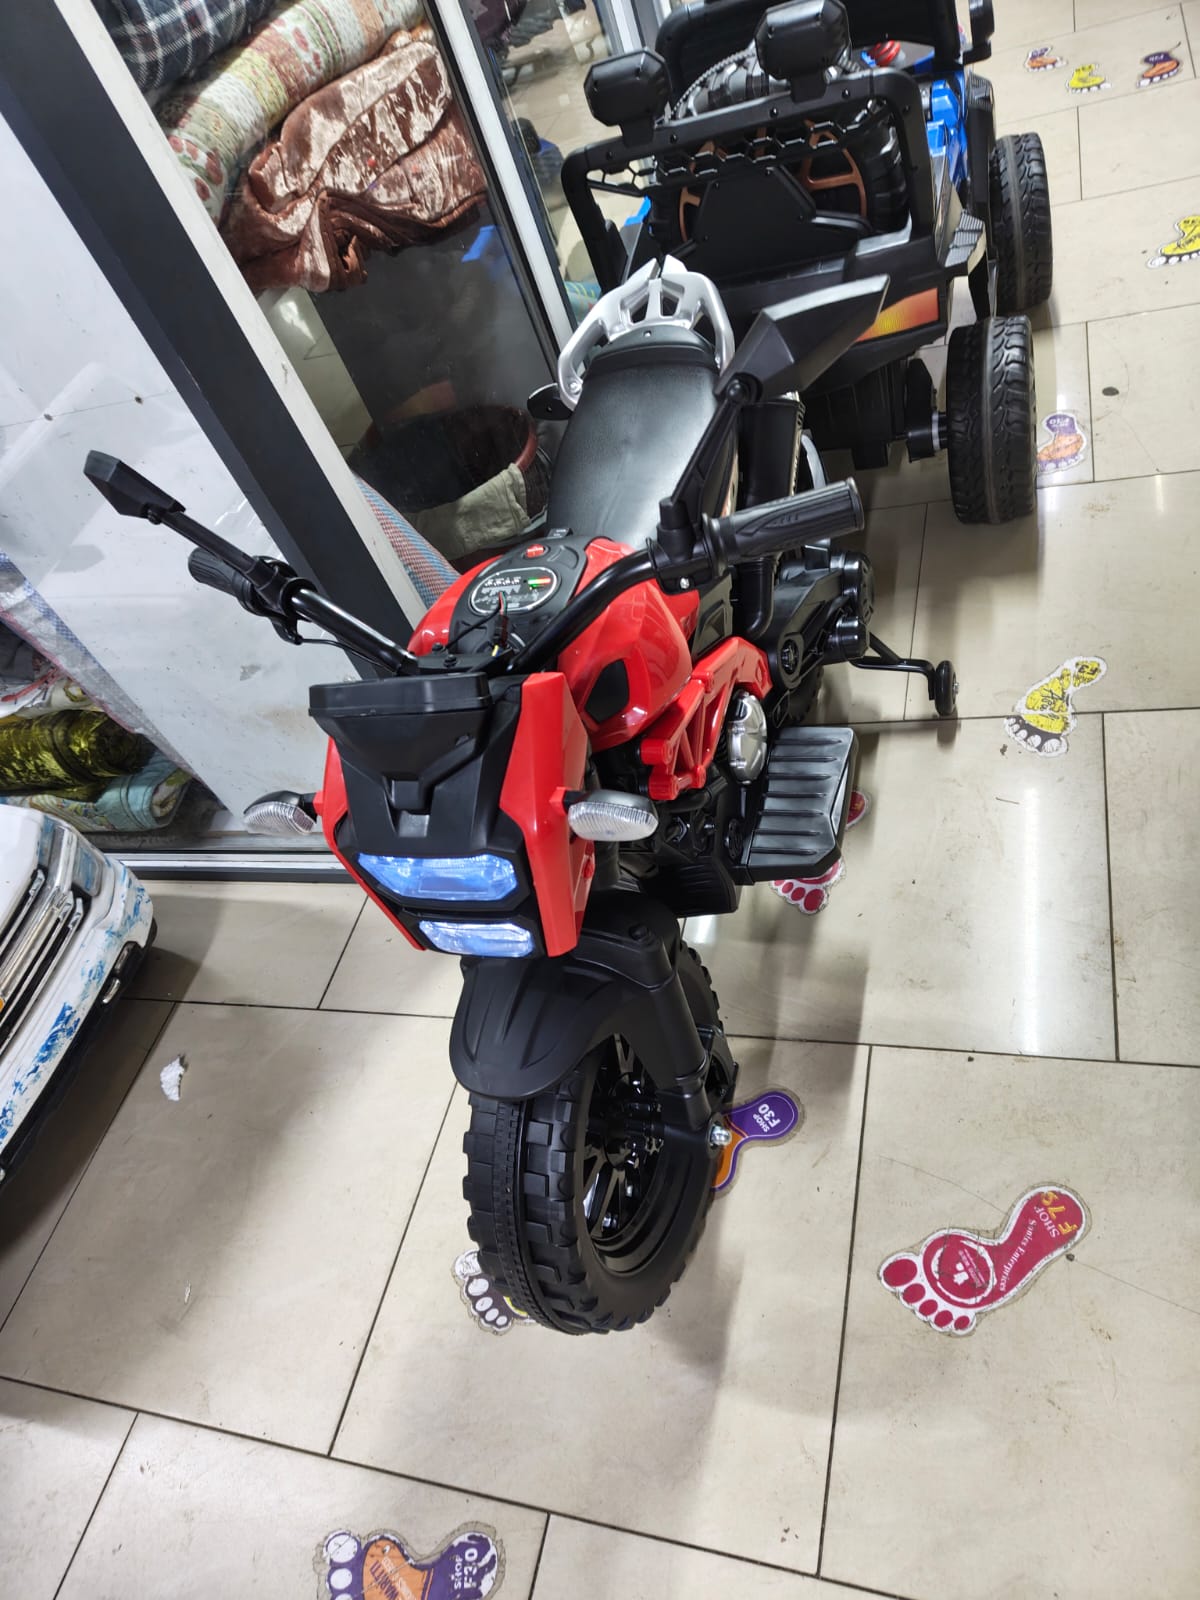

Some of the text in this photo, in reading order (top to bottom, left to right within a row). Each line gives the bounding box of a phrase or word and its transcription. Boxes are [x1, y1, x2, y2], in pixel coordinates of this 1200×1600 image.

[753, 1114, 770, 1133] SHOP
[758, 1104, 781, 1128] F30
[1034, 1206, 1060, 1238] SHOP
